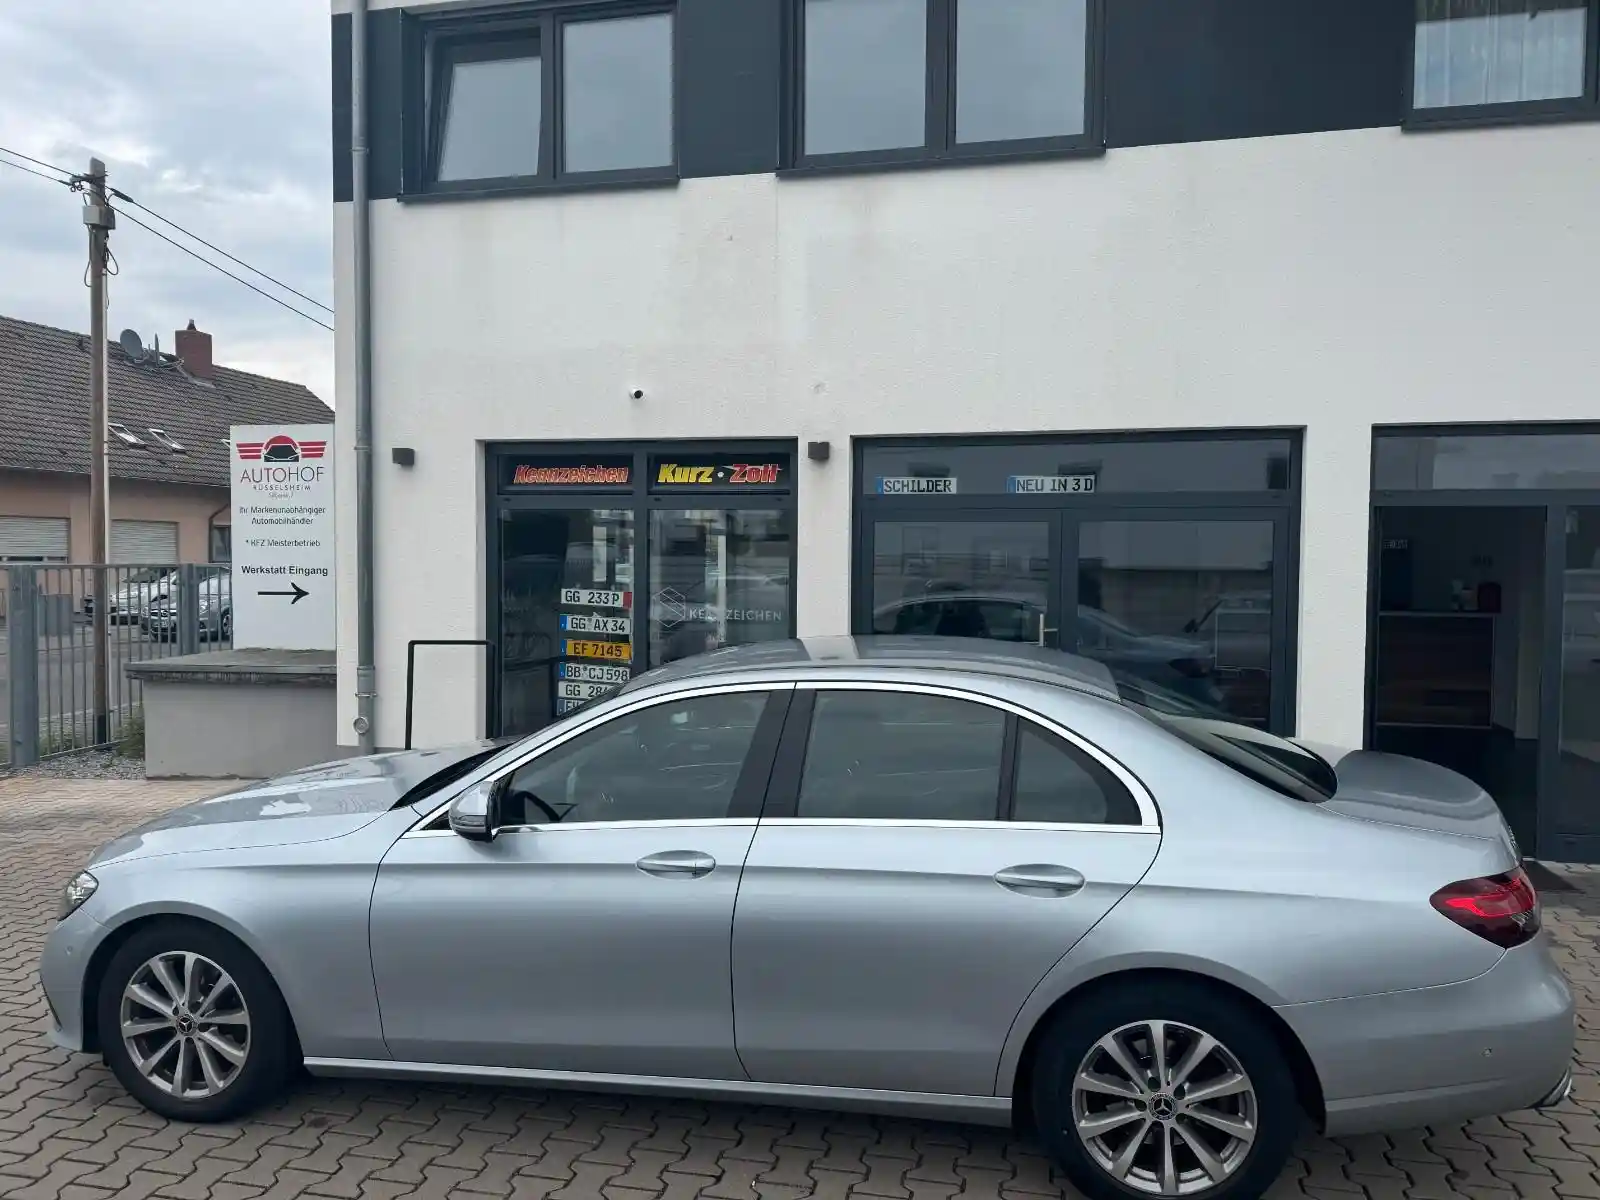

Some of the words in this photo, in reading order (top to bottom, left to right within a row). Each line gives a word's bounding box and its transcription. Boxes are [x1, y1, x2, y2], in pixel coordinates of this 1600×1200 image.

[240, 466, 325, 483] AUTOHOF
[513, 464, 629, 484] Kennzeichen
[658, 463, 713, 483] Kurz
[883, 479, 952, 493] SCHILDER
[1016, 478, 1044, 492] NEU
[1050, 478, 1067, 492] IN
[250, 506, 326, 515] Markenunabhängiger
[251, 517, 314, 525] Automobilhändler
[267, 538, 321, 547] Meisterbetrieb
[241, 565, 286, 574] Werkstatt
[288, 565, 328, 576] Eingang
[564, 590, 581, 603] GG
[689, 608, 782, 621] KEZEICHEN
[570, 619, 586, 632] GG
[573, 642, 588, 655] EF
[592, 643, 622, 657] 7145
[566, 665, 581, 678] BB
[565, 684, 581, 696] GG
